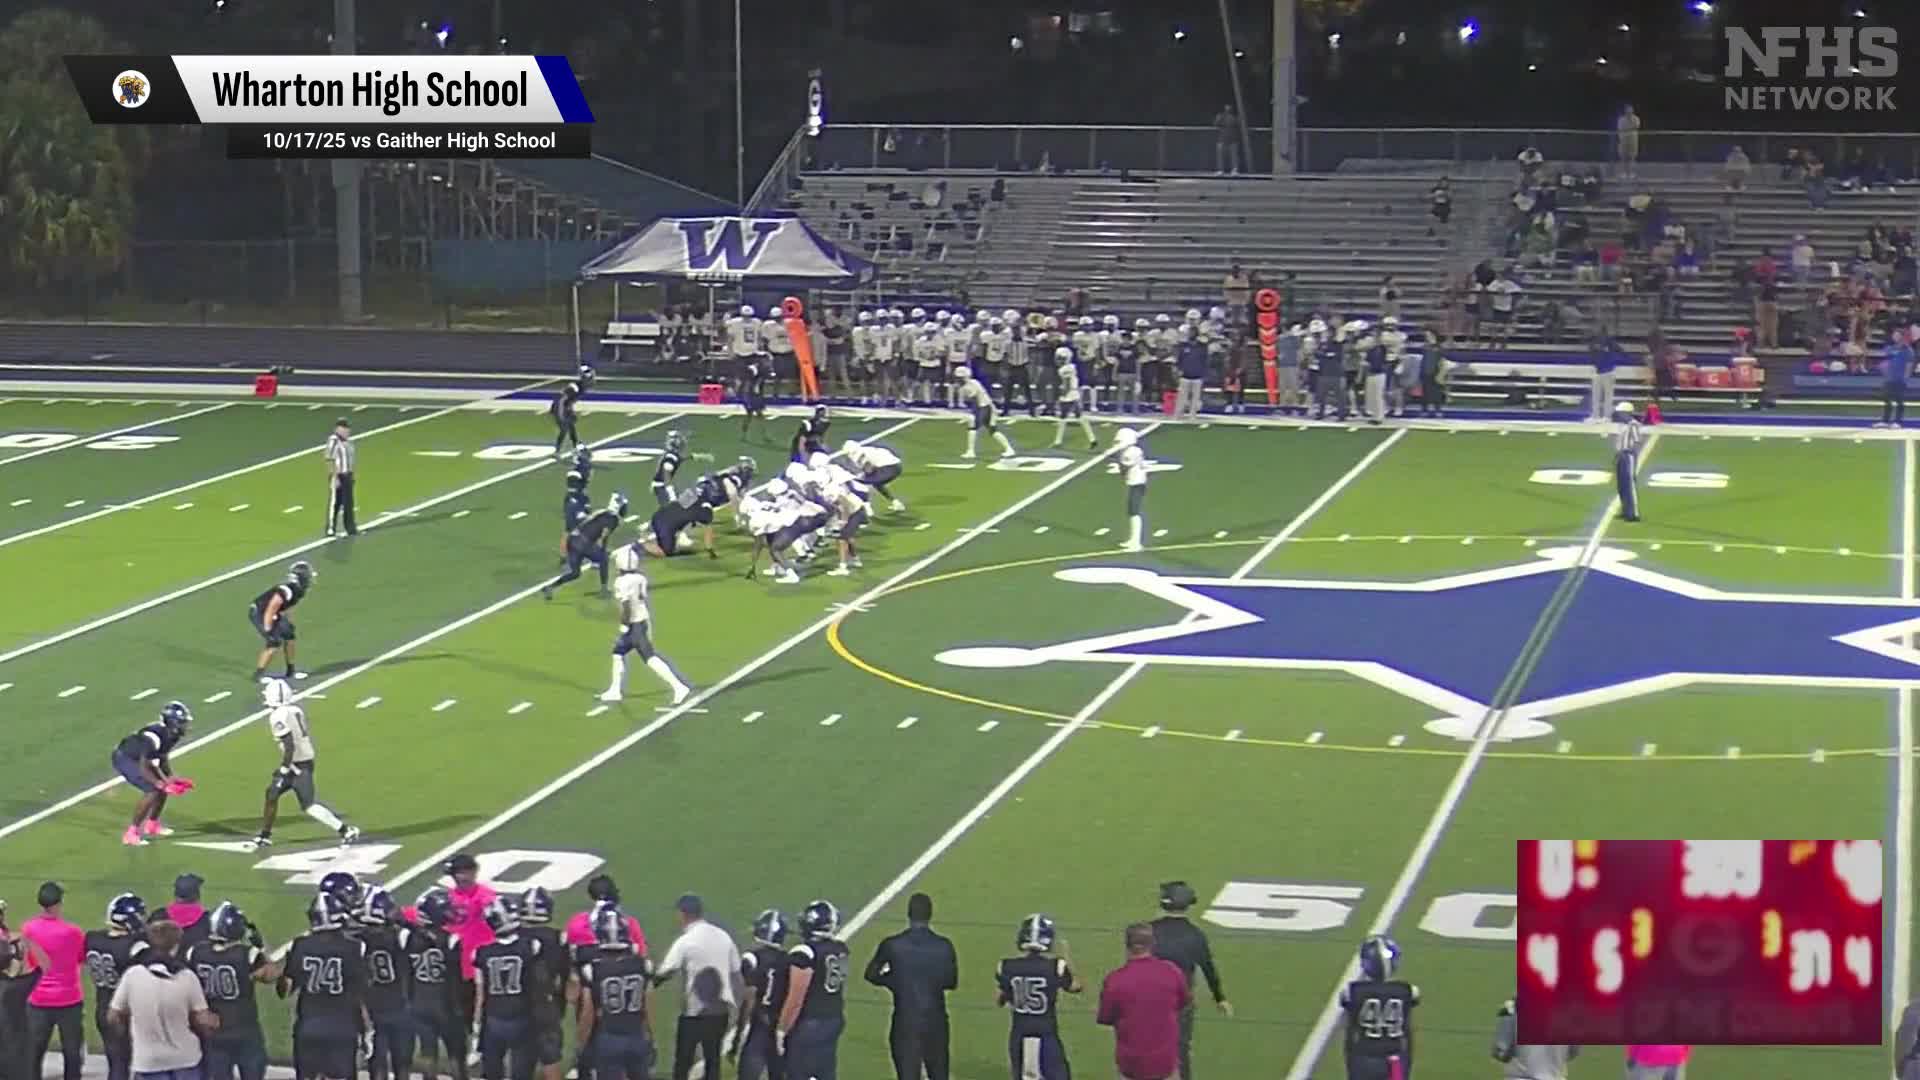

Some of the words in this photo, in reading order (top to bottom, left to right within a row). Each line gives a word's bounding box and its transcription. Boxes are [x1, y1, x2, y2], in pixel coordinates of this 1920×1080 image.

[677, 220, 782, 271] W
[303, 956, 344, 995] 74
[487, 955, 524, 995] 17
[1010, 976, 1048, 1015] 15
[1358, 997, 1405, 1039] 44
